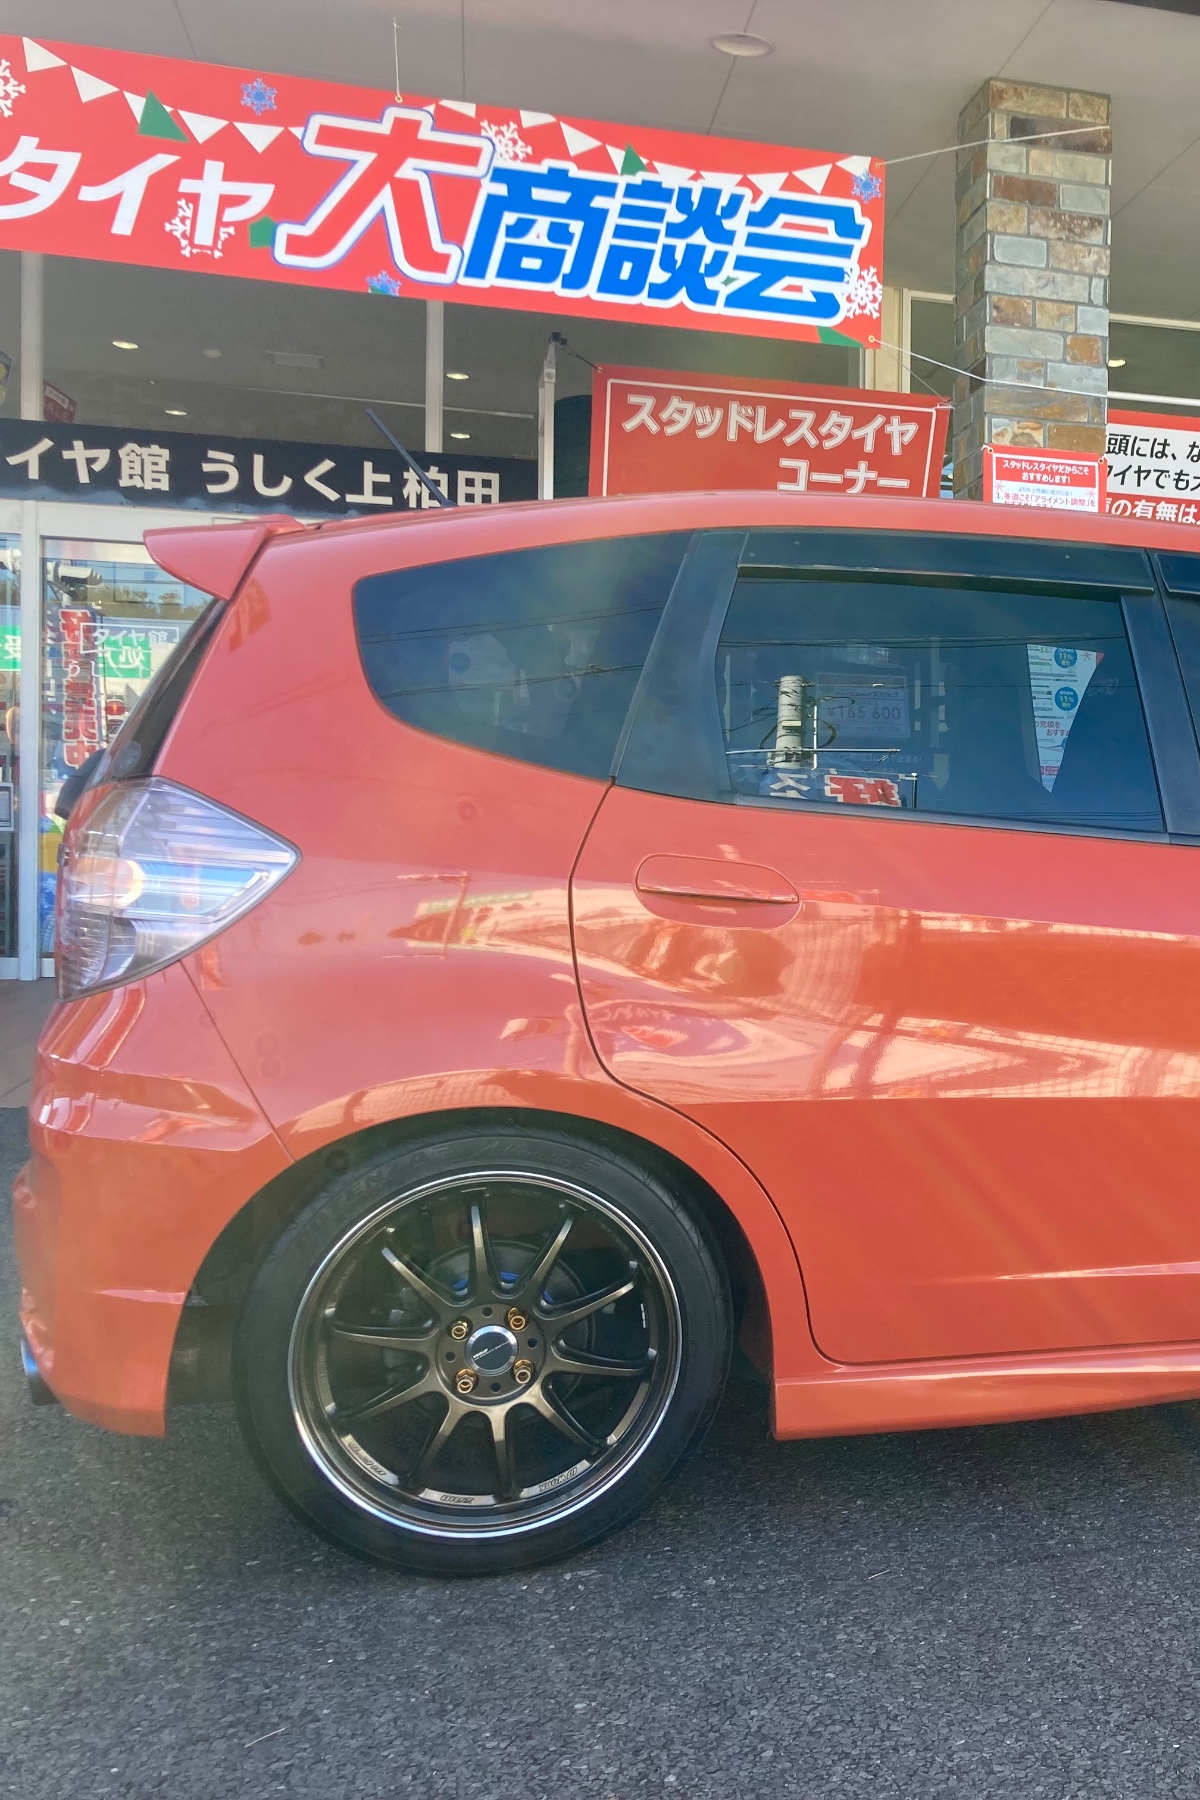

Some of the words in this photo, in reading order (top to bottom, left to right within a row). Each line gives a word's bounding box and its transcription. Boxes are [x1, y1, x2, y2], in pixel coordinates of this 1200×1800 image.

[621, 393, 919, 456] スタッドレスタイヤ
[5, 437, 171, 493] イヤ館
[201, 449, 501, 509] うしく上柏田
[776, 457, 910, 495] コーナー
[1002, 459, 1090, 475] スタッドレスタイヤだからこそ
